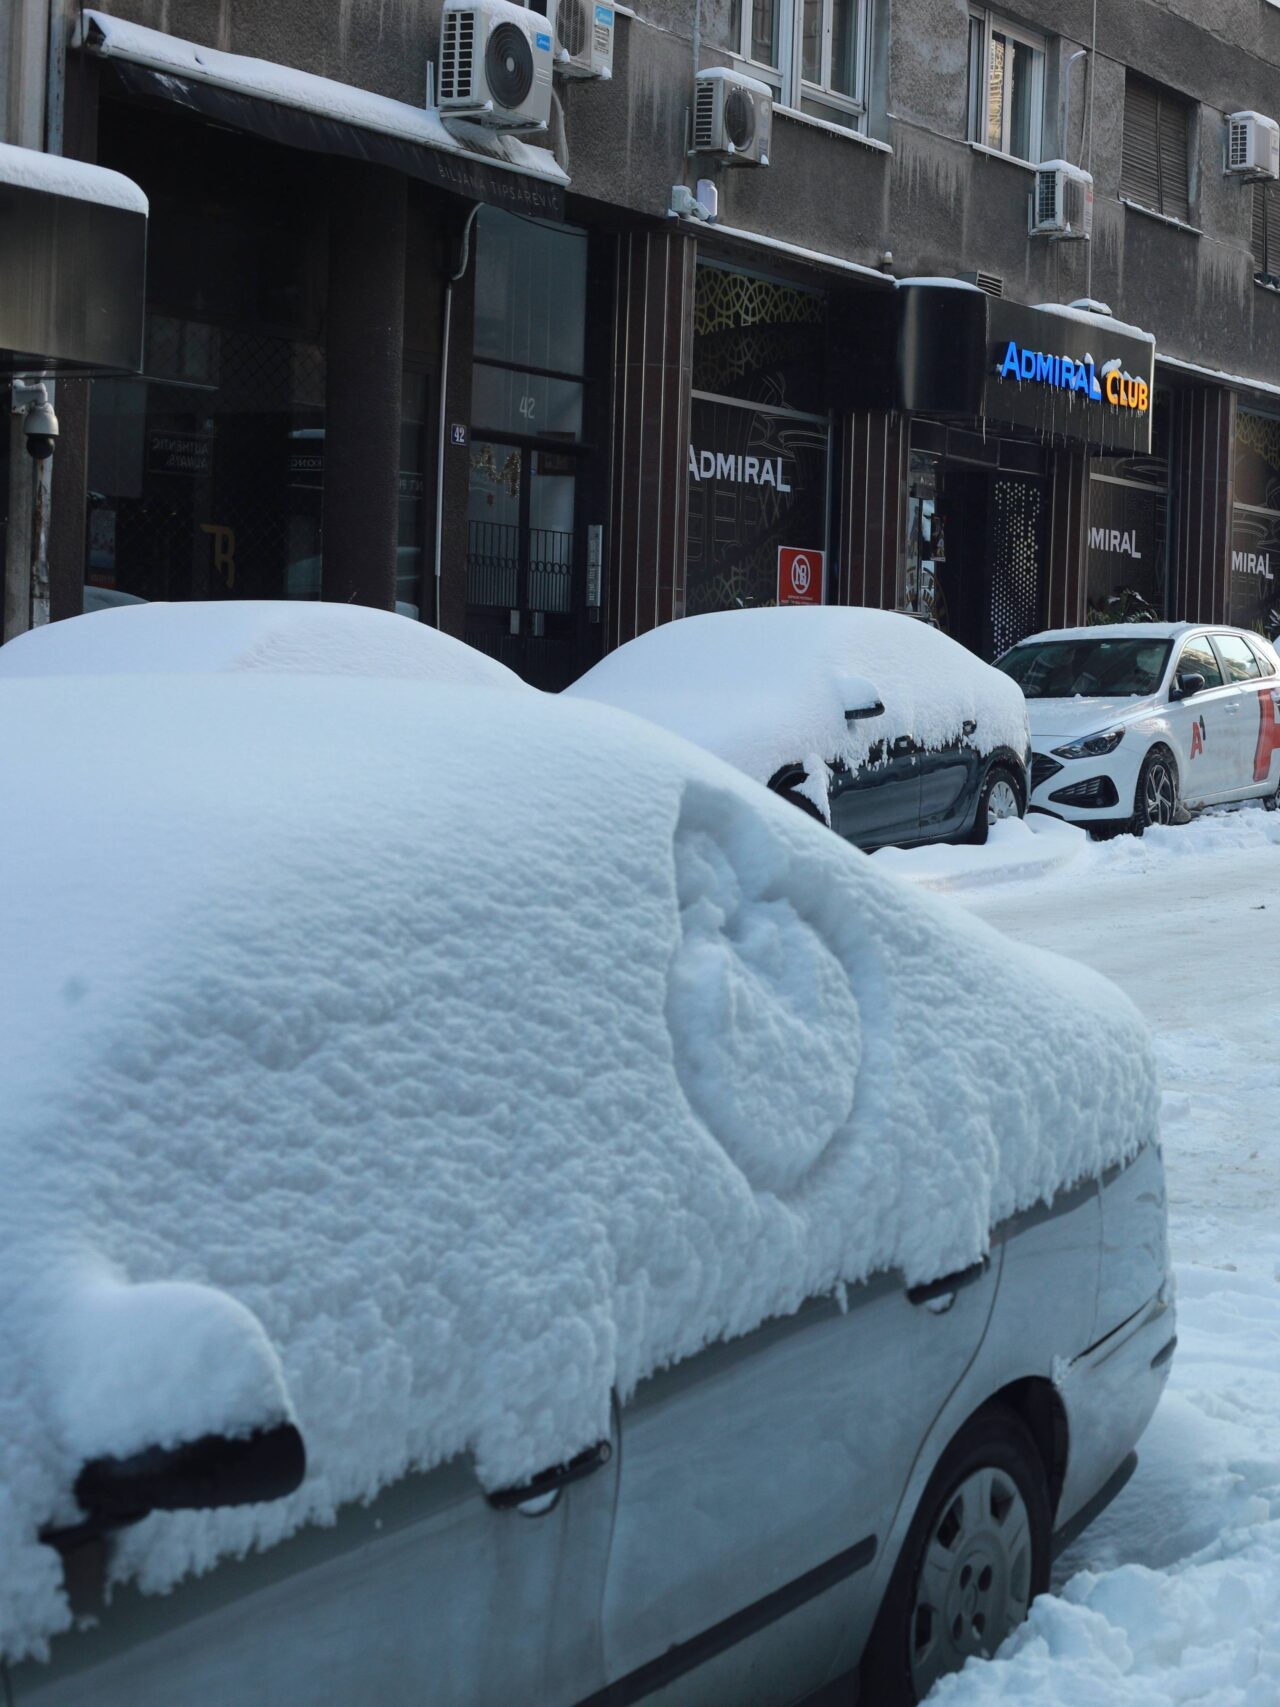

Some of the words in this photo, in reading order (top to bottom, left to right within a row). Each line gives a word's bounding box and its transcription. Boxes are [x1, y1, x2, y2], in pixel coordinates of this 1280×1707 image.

[1001, 341, 1102, 402] ADMIRAL
[1106, 367, 1149, 411] CLUB
[519, 396, 536, 419] 42
[453, 427, 465, 443] 42
[688, 443, 792, 493] ADMIRAL
[1088, 526, 1142, 559] MIRAL
